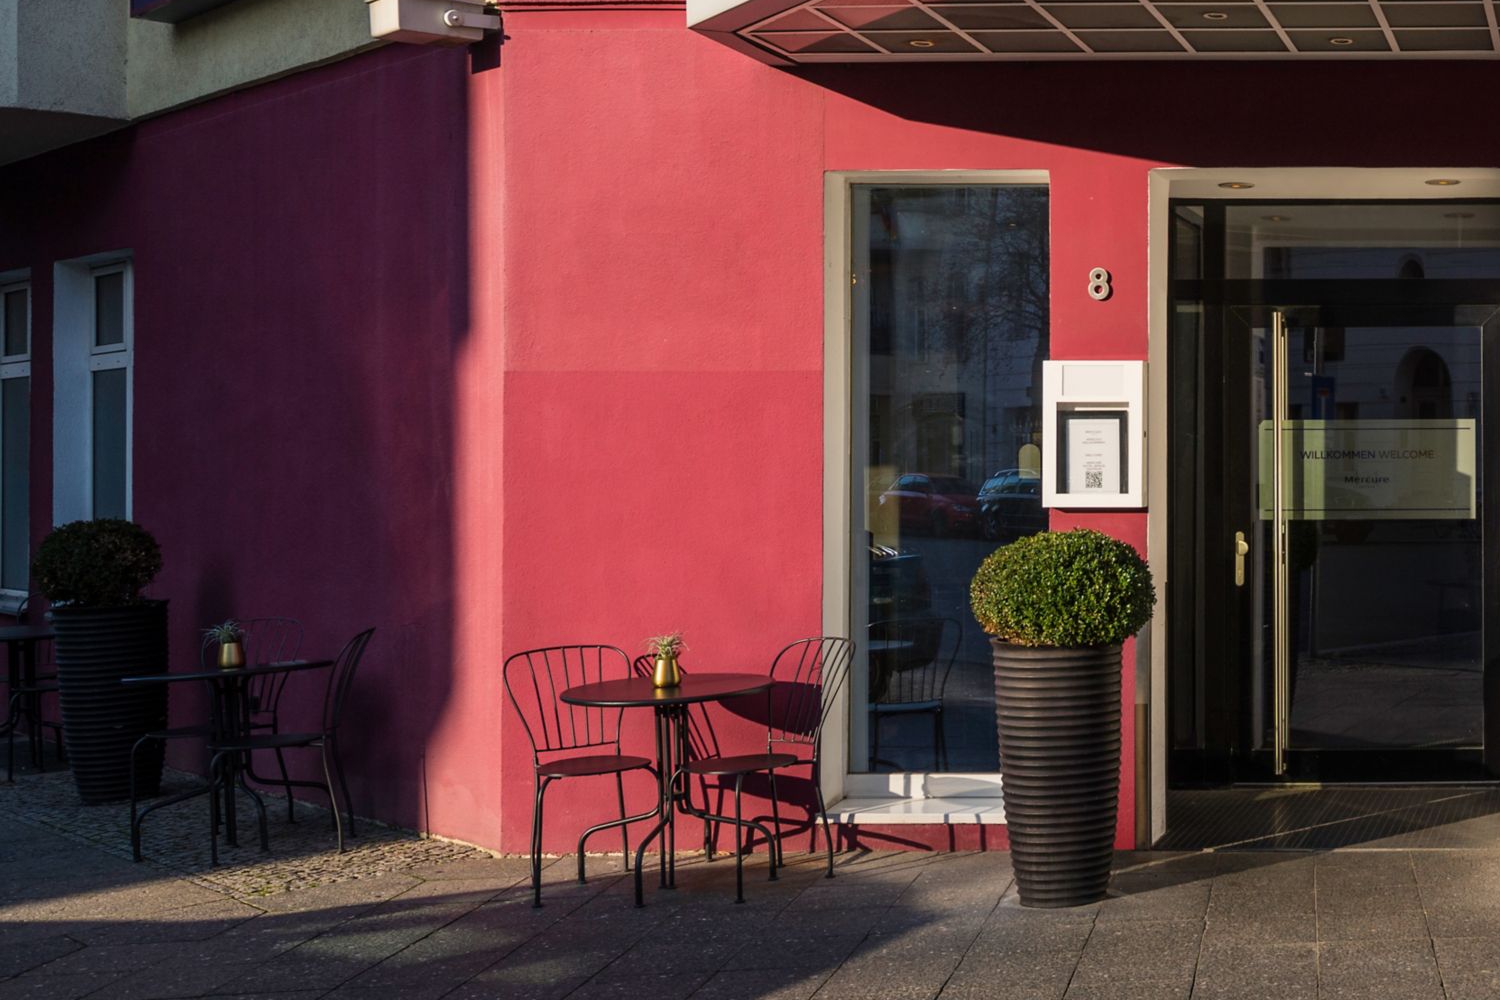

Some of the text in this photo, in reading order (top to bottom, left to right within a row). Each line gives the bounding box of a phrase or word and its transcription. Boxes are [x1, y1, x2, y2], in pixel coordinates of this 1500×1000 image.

[1088, 266, 1110, 301] 8
[1301, 450, 1435, 460] WILLKOMMEN WELCOME
[1344, 475, 1390, 485] Mercure
